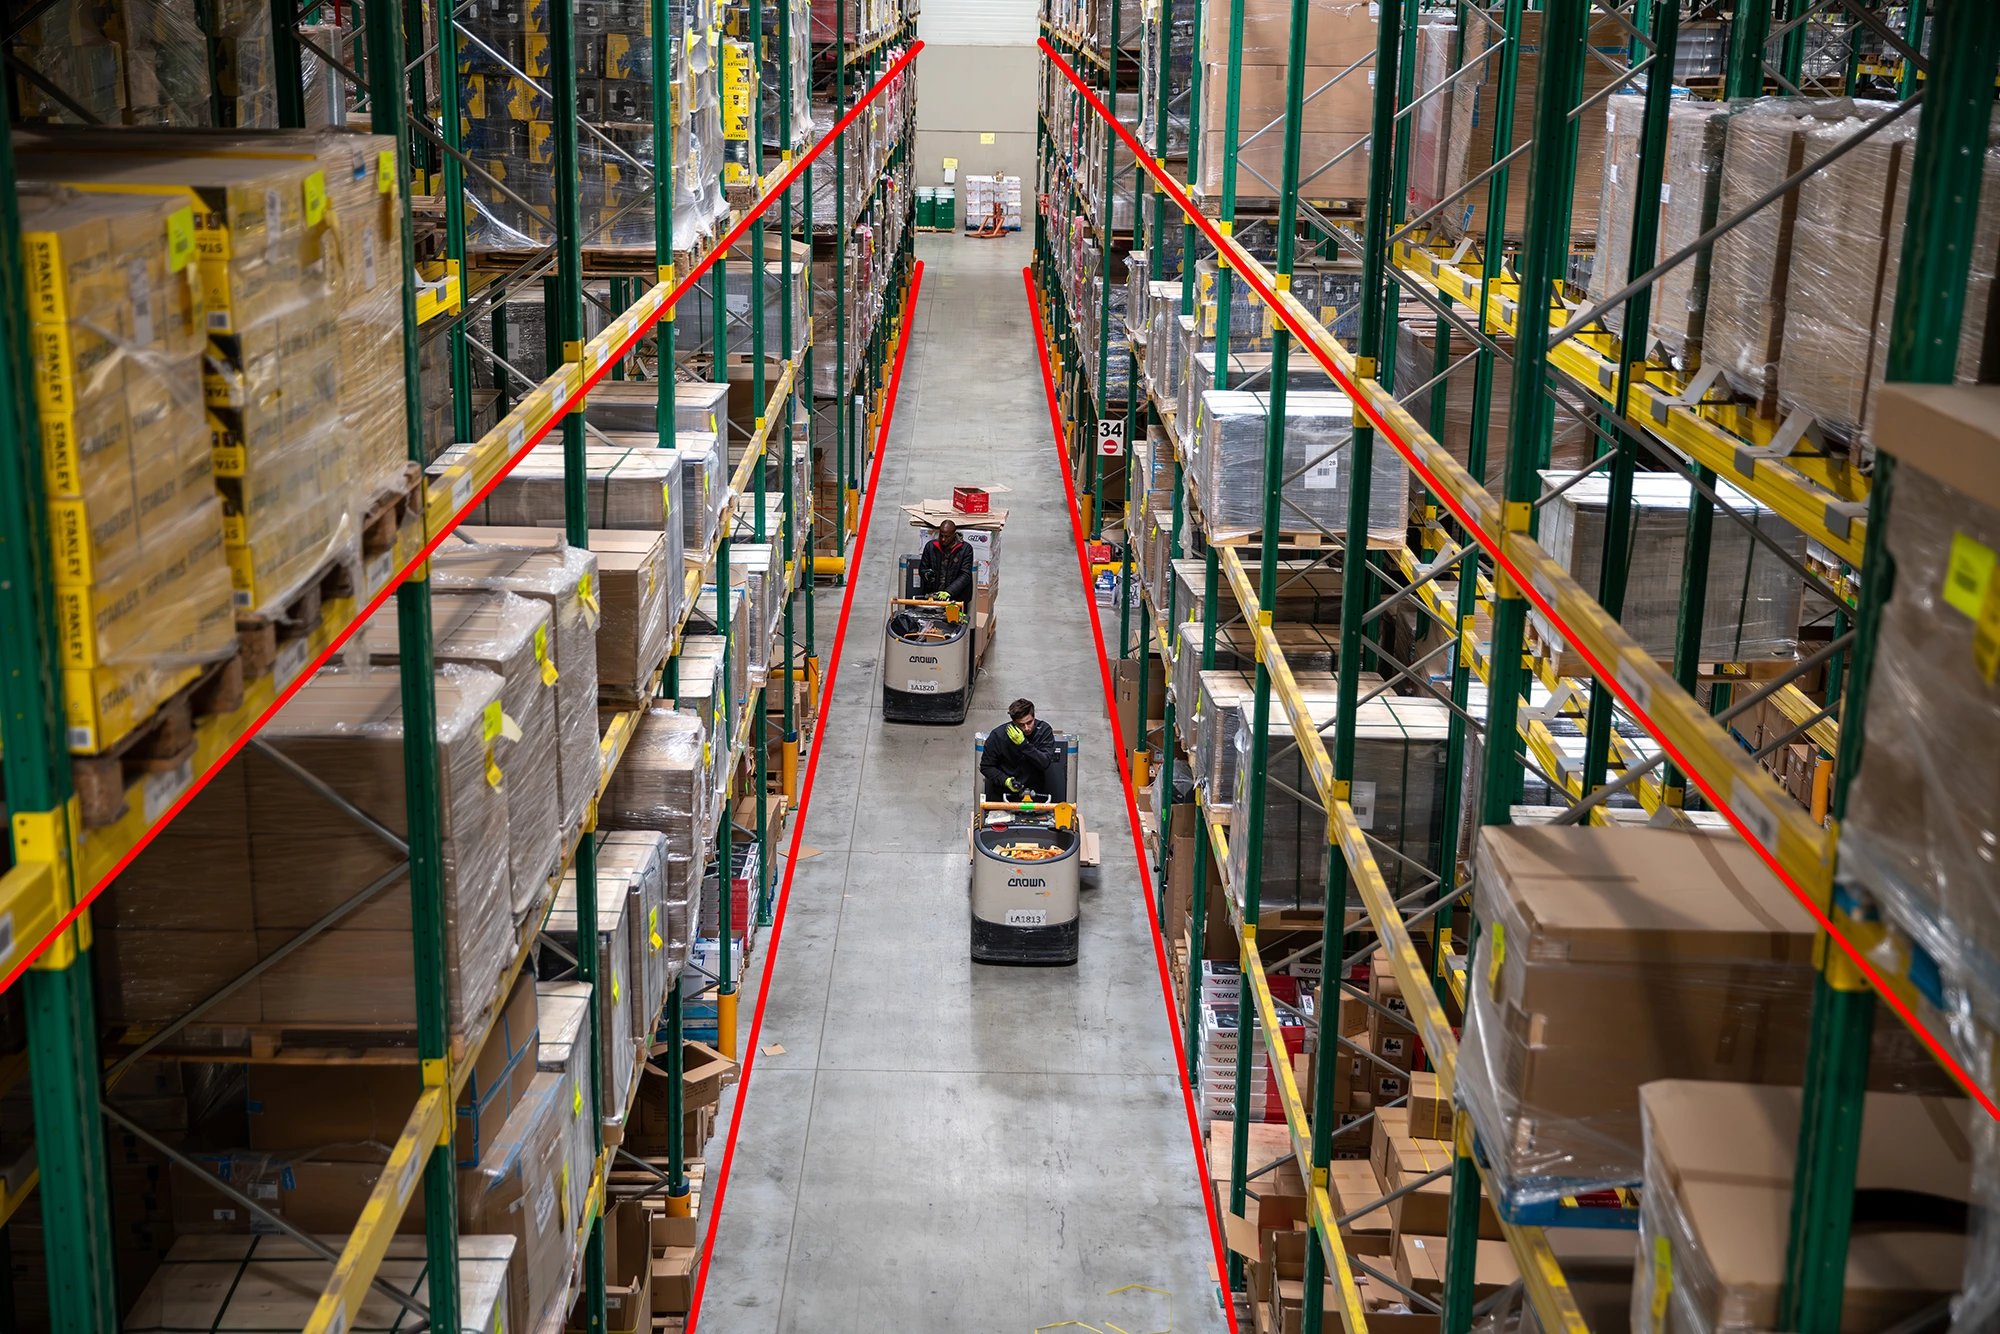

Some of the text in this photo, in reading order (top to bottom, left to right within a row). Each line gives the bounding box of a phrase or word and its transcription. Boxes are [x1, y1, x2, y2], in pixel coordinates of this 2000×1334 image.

[37, 241, 55, 315] STANLEY
[44, 333, 63, 404] STANLEY
[52, 421, 71, 491] STANLEY
[1100, 422, 1122, 437] 34
[64, 509, 82, 578] STANLEY
[66, 594, 83, 661] STANLEY
[909, 655, 938, 664] CROWN
[1007, 878, 1046, 887] CROWN
[1010, 915, 1041, 924] LA1813
